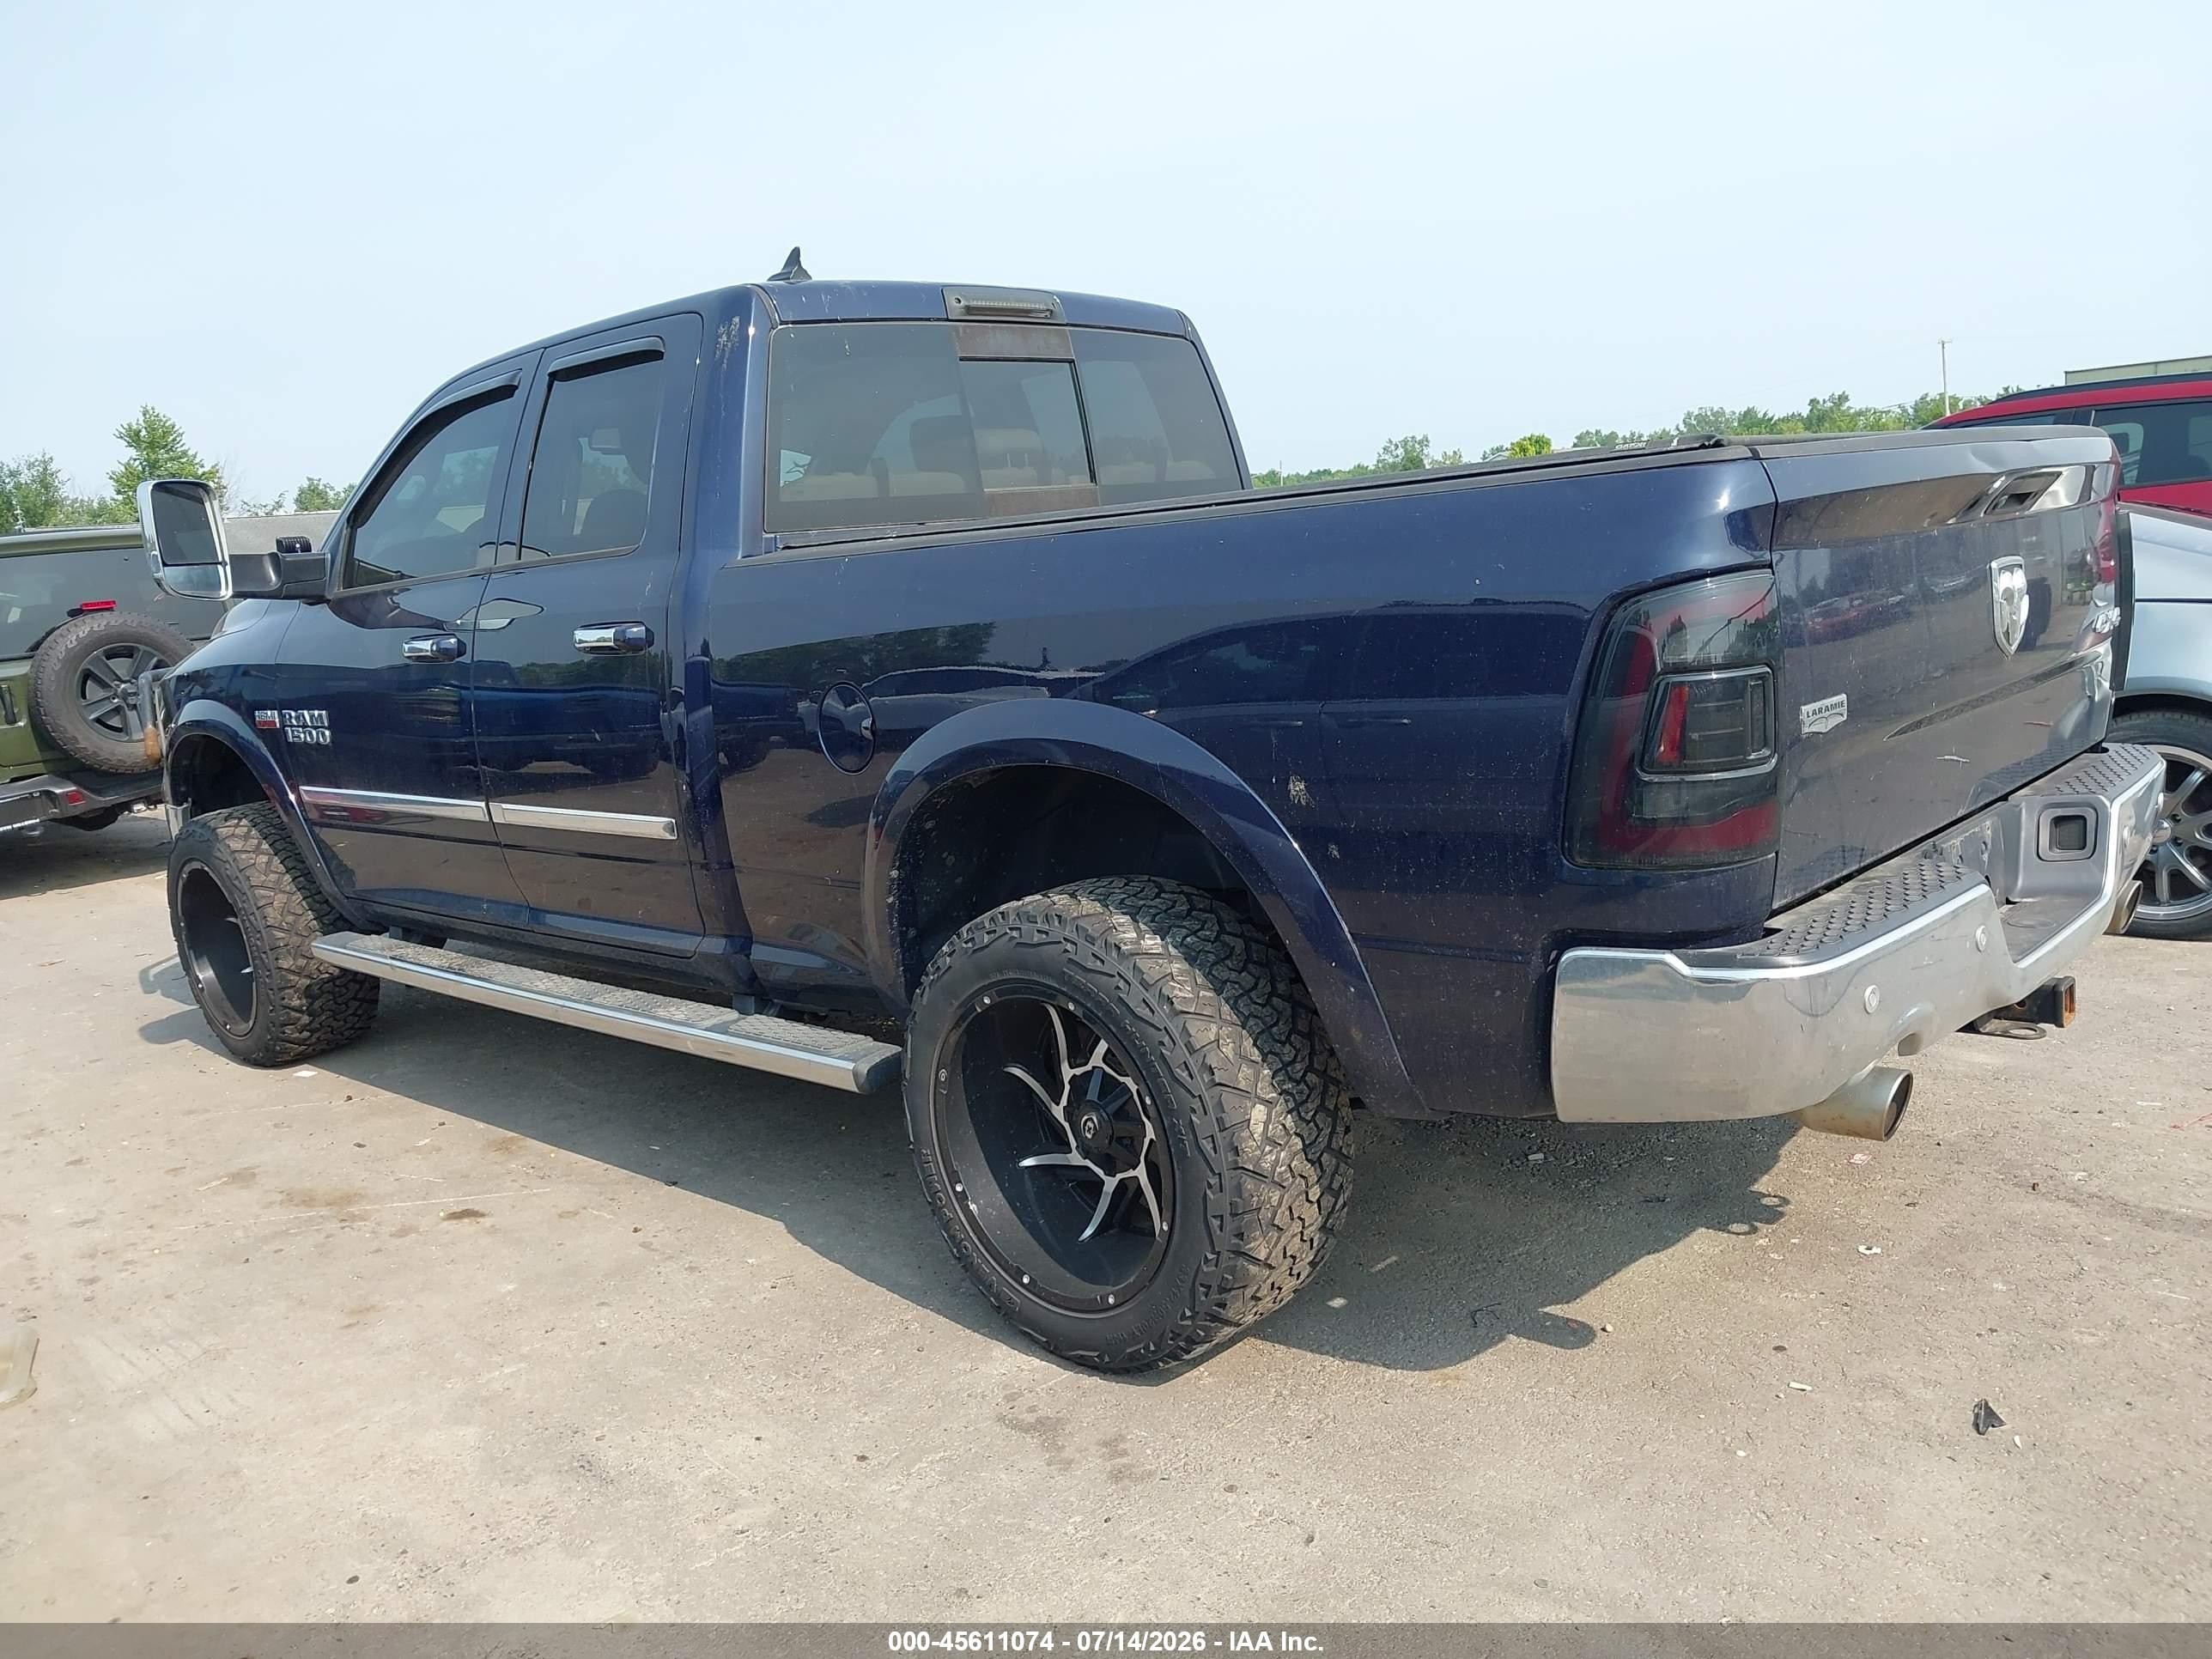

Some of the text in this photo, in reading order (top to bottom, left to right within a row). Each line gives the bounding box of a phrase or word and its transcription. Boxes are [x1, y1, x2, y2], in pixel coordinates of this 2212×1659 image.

[282, 709, 329, 726] RAM
[1806, 700, 1845, 718] LARAMIE
[284, 726, 331, 744] 1500
[921, 1148, 955, 1220] POWER
